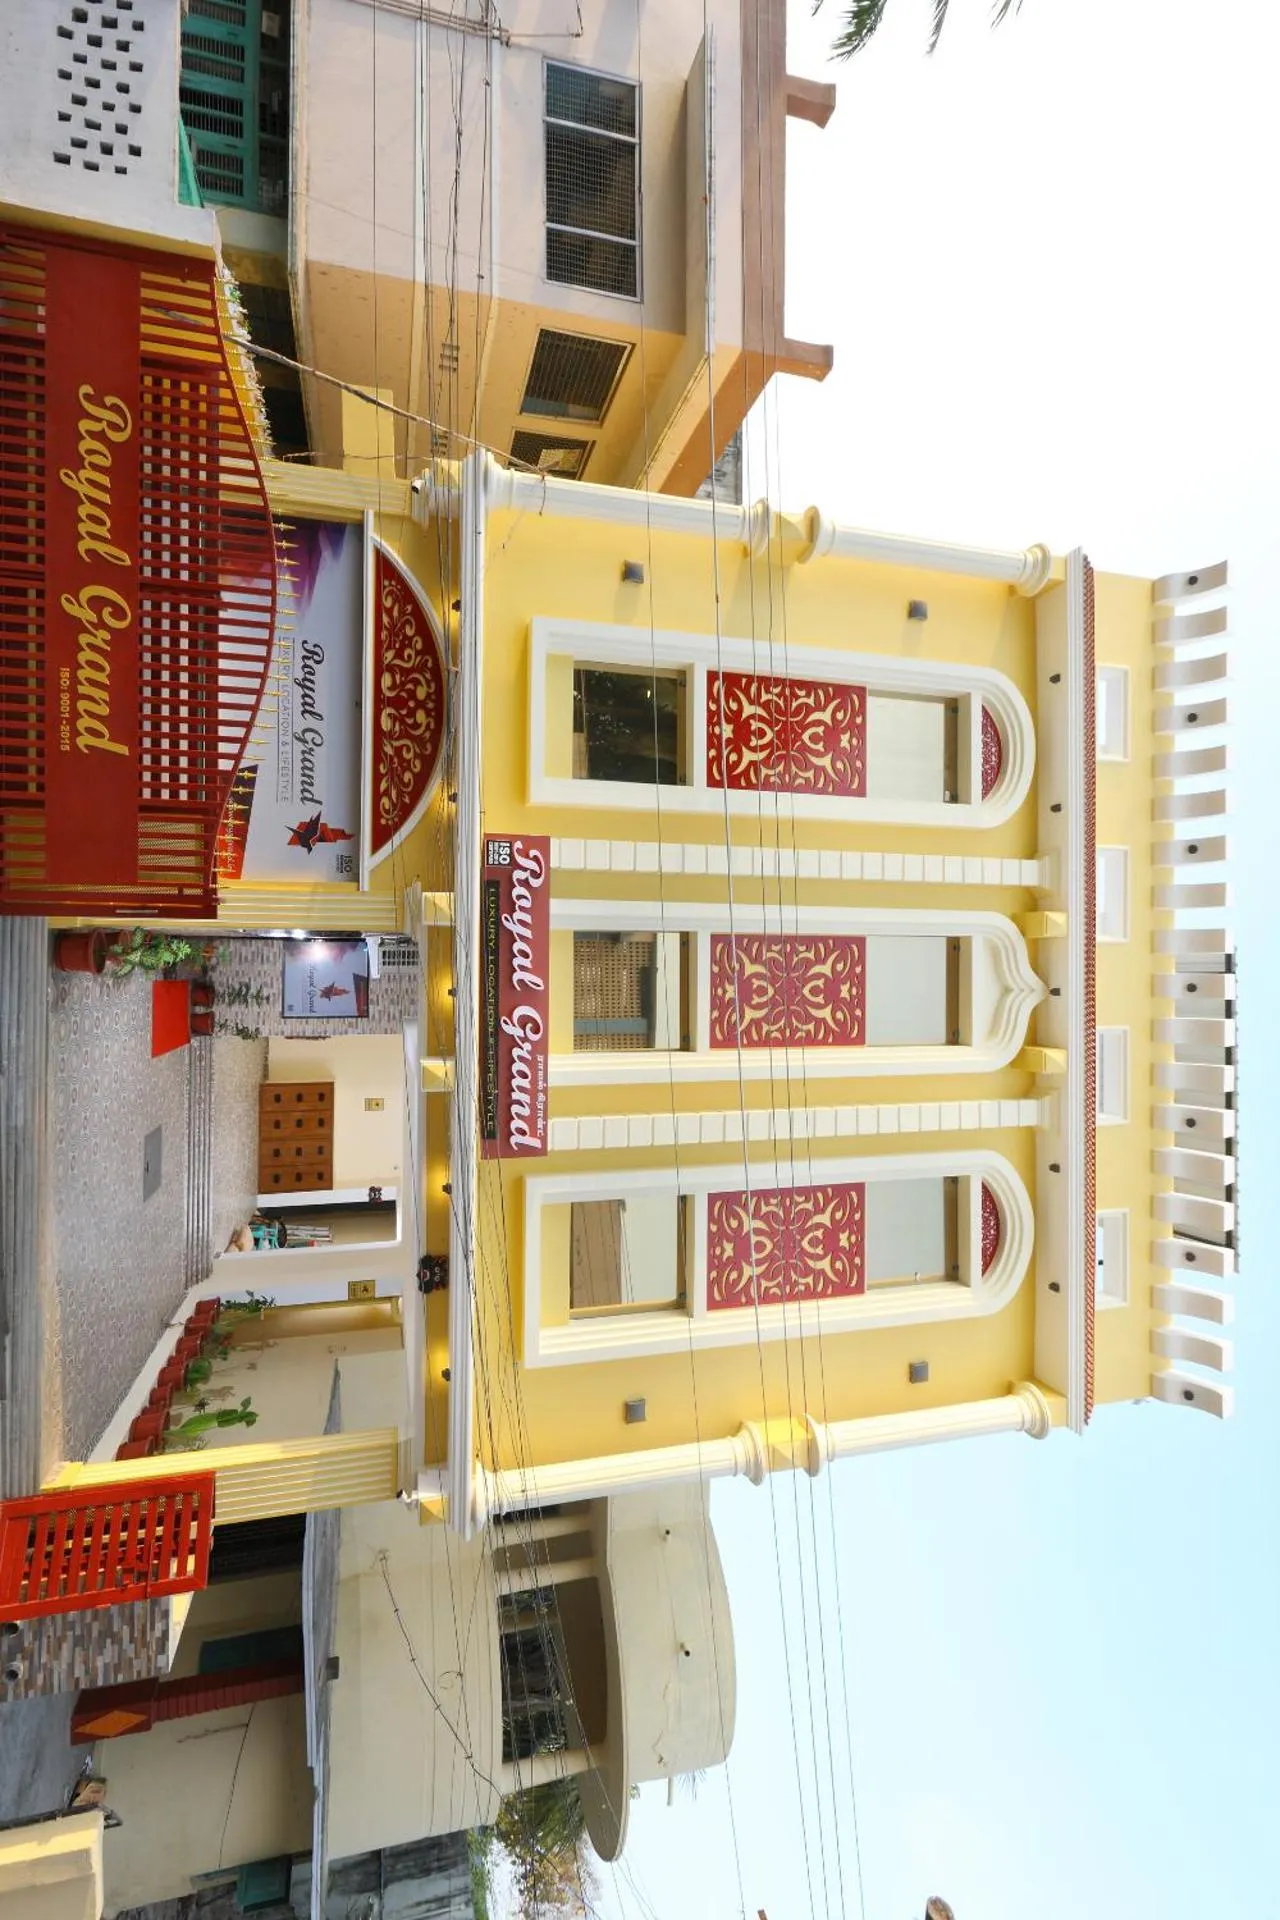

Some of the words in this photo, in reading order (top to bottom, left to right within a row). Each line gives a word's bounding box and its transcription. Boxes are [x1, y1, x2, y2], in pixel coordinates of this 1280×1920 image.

[59, 384, 132, 567] Royal
[60, 667, 70, 690] ISO:
[61, 584, 132, 757] Grand
[294, 640, 325, 721] Royal
[281, 751, 289, 802] LIFESTYLE
[293, 727, 324, 806] Grand
[343, 855, 352, 873] ISO
[499, 842, 511, 865] ISO
[501, 840, 545, 991] Royal
[500, 1005, 544, 1150] Grand
